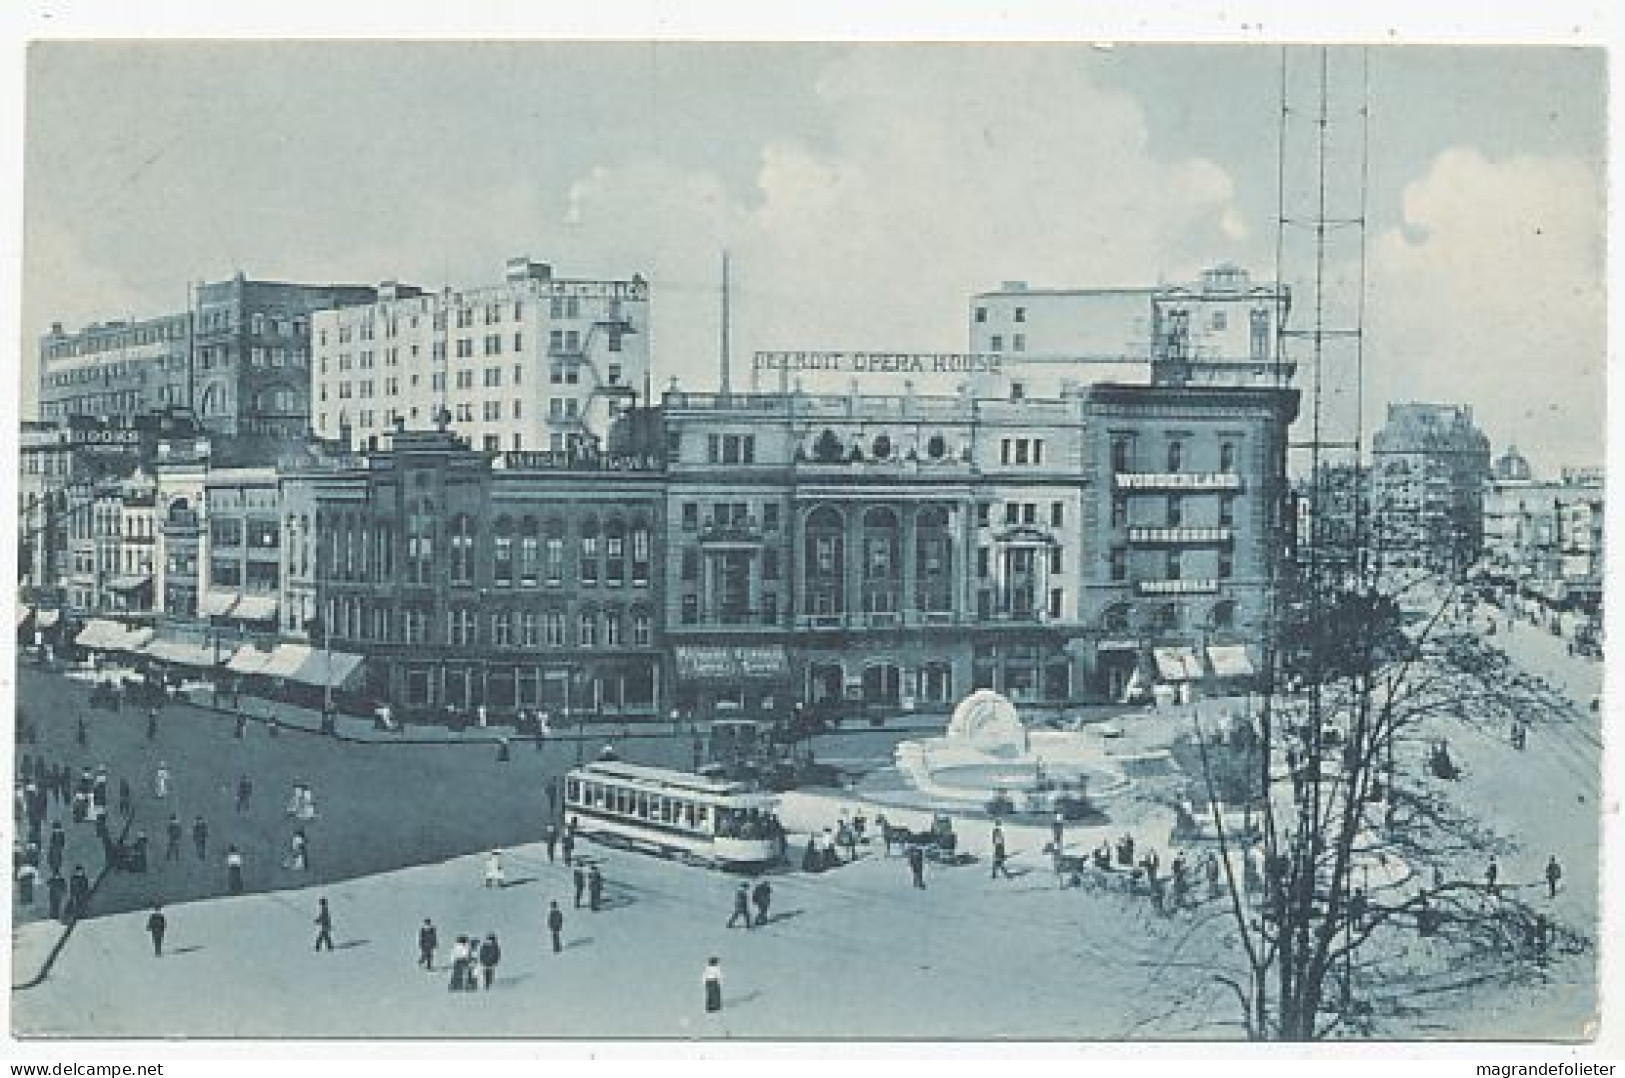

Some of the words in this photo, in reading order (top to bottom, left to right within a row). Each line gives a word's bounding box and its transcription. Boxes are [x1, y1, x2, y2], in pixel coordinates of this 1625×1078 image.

[754, 351, 843, 370] DETROIT
[854, 353, 923, 372] OPERA
[933, 354, 1002, 375] HOUSE
[1115, 473, 1239, 488] WONDERLAND
